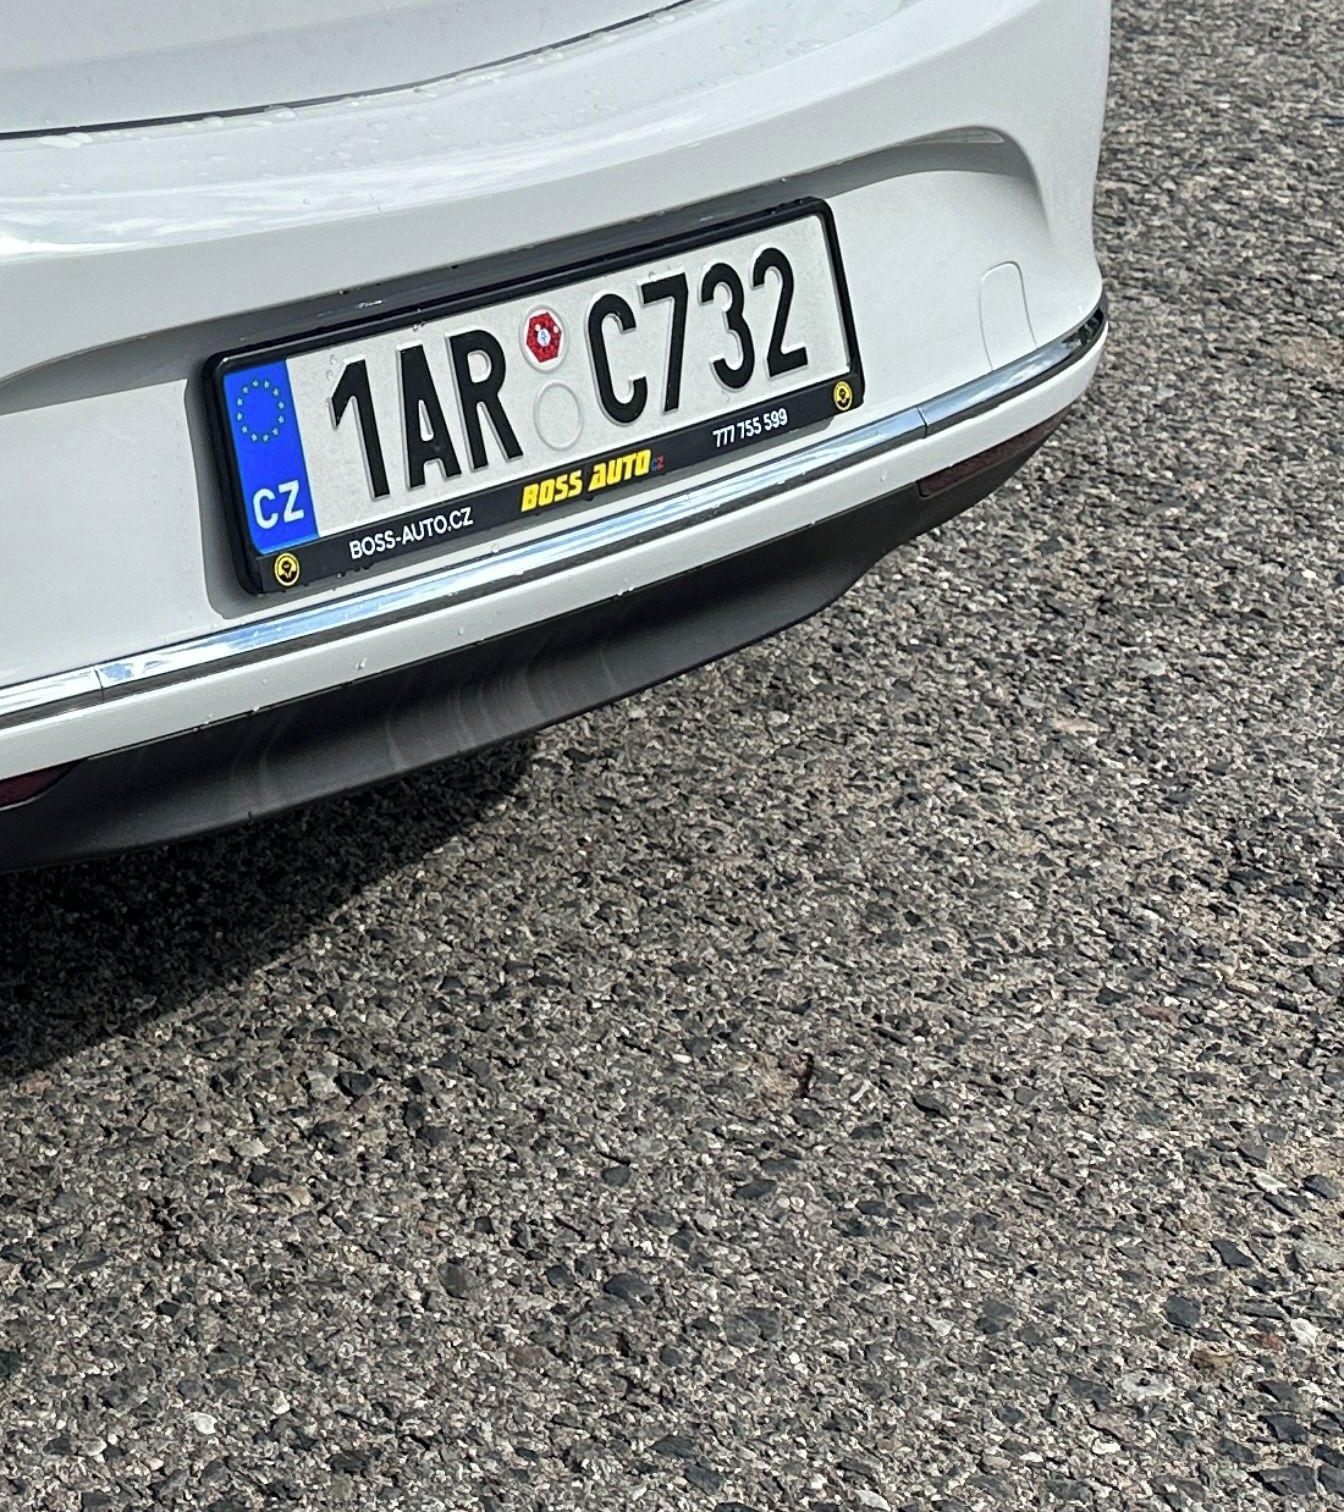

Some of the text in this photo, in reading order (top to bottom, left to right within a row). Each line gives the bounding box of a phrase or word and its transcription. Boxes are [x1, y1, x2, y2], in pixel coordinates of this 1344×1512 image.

[326, 246, 810, 501] 1AR C732
[713, 408, 788, 448] 777 755 599
[252, 479, 304, 530] CZ
[520, 469, 583, 512] BOSS
[587, 449, 652, 492] AUTO
[348, 507, 474, 559] BOSS-AUTO.CZ
